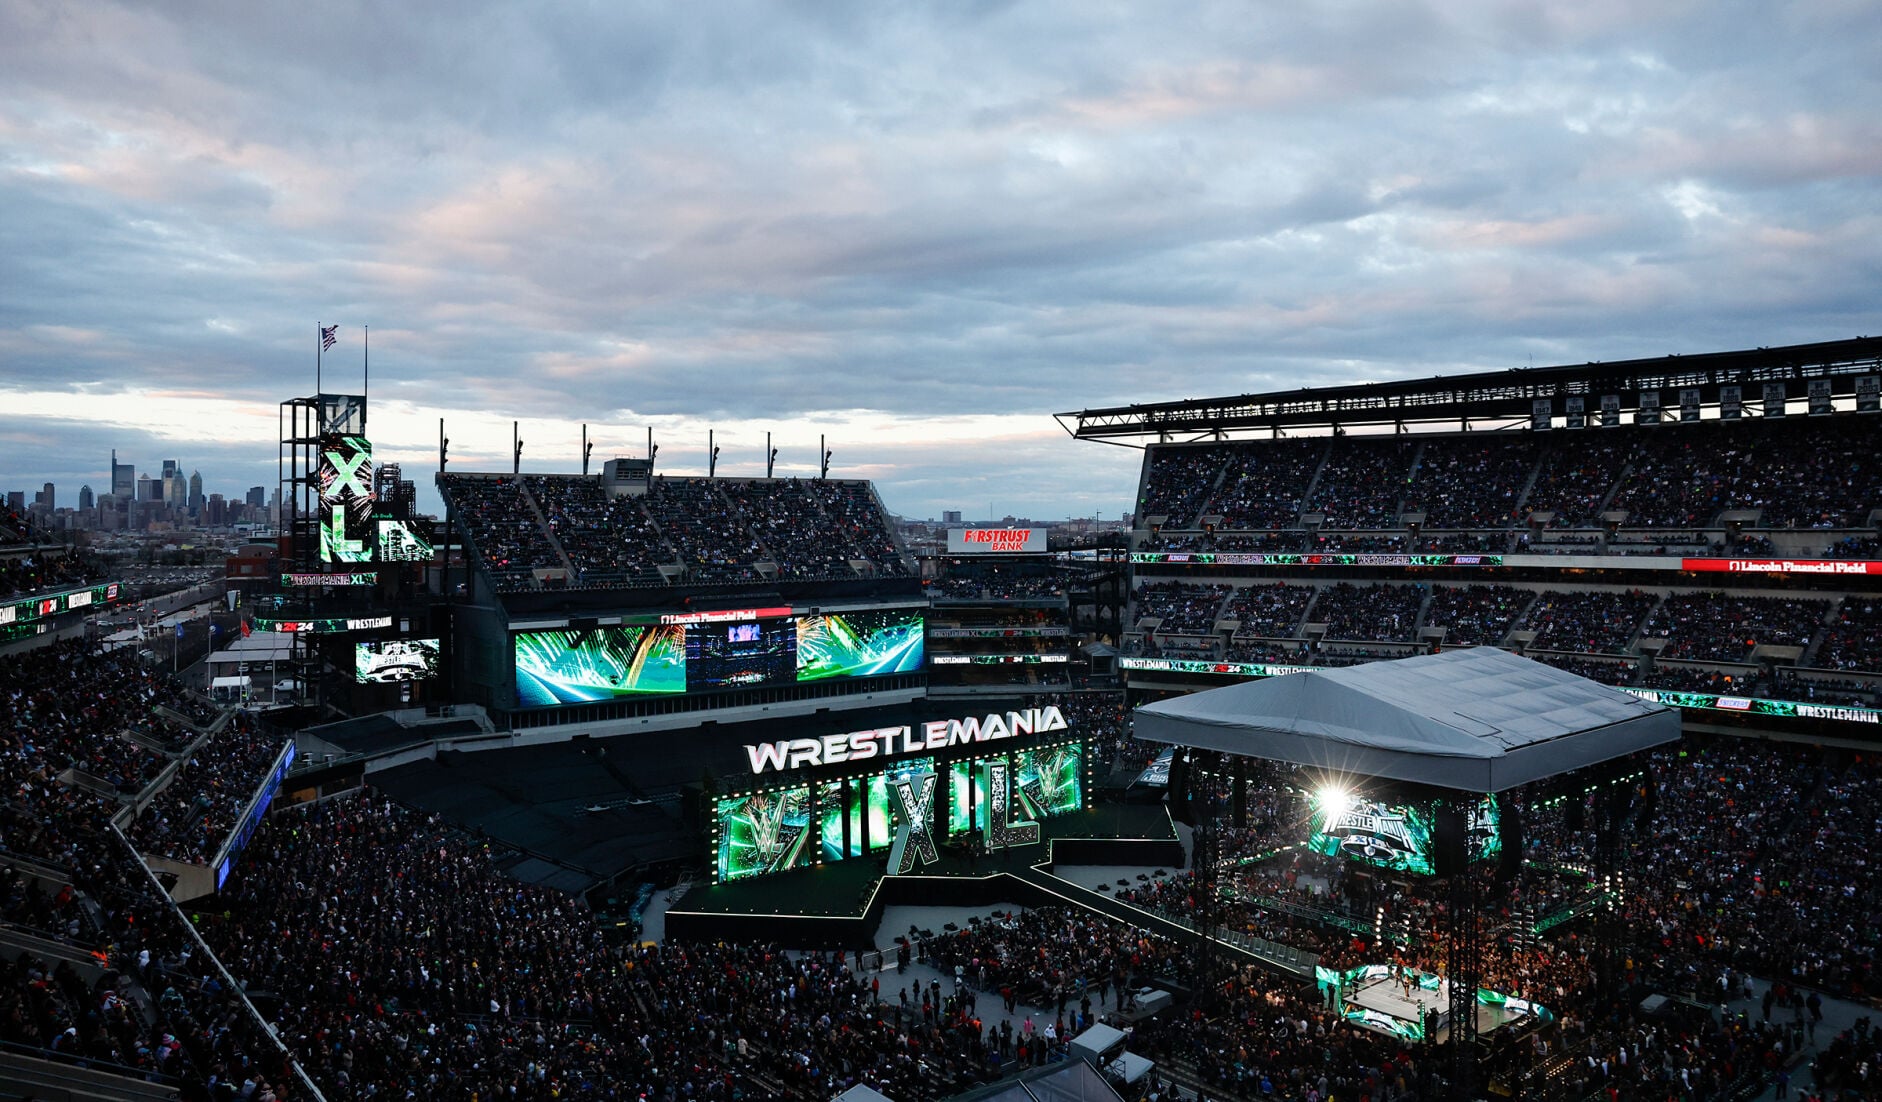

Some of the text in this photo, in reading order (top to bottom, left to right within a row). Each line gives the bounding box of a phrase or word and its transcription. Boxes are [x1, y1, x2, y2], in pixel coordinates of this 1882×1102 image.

[991, 542, 1023, 551] BANK
[1131, 554, 1144, 562] XL
[1264, 555, 1277, 564] XL
[1410, 556, 1424, 565] XL
[1741, 561, 1867, 573] Lincoln Financial Field
[351, 574, 365, 585] XL
[670, 610, 756, 624] Lincoln Financial Field
[282, 622, 314, 631] 2K24
[1796, 704, 1879, 724] WRESTLEMANIA
[744, 706, 1068, 774] WRESTLEMANIA
